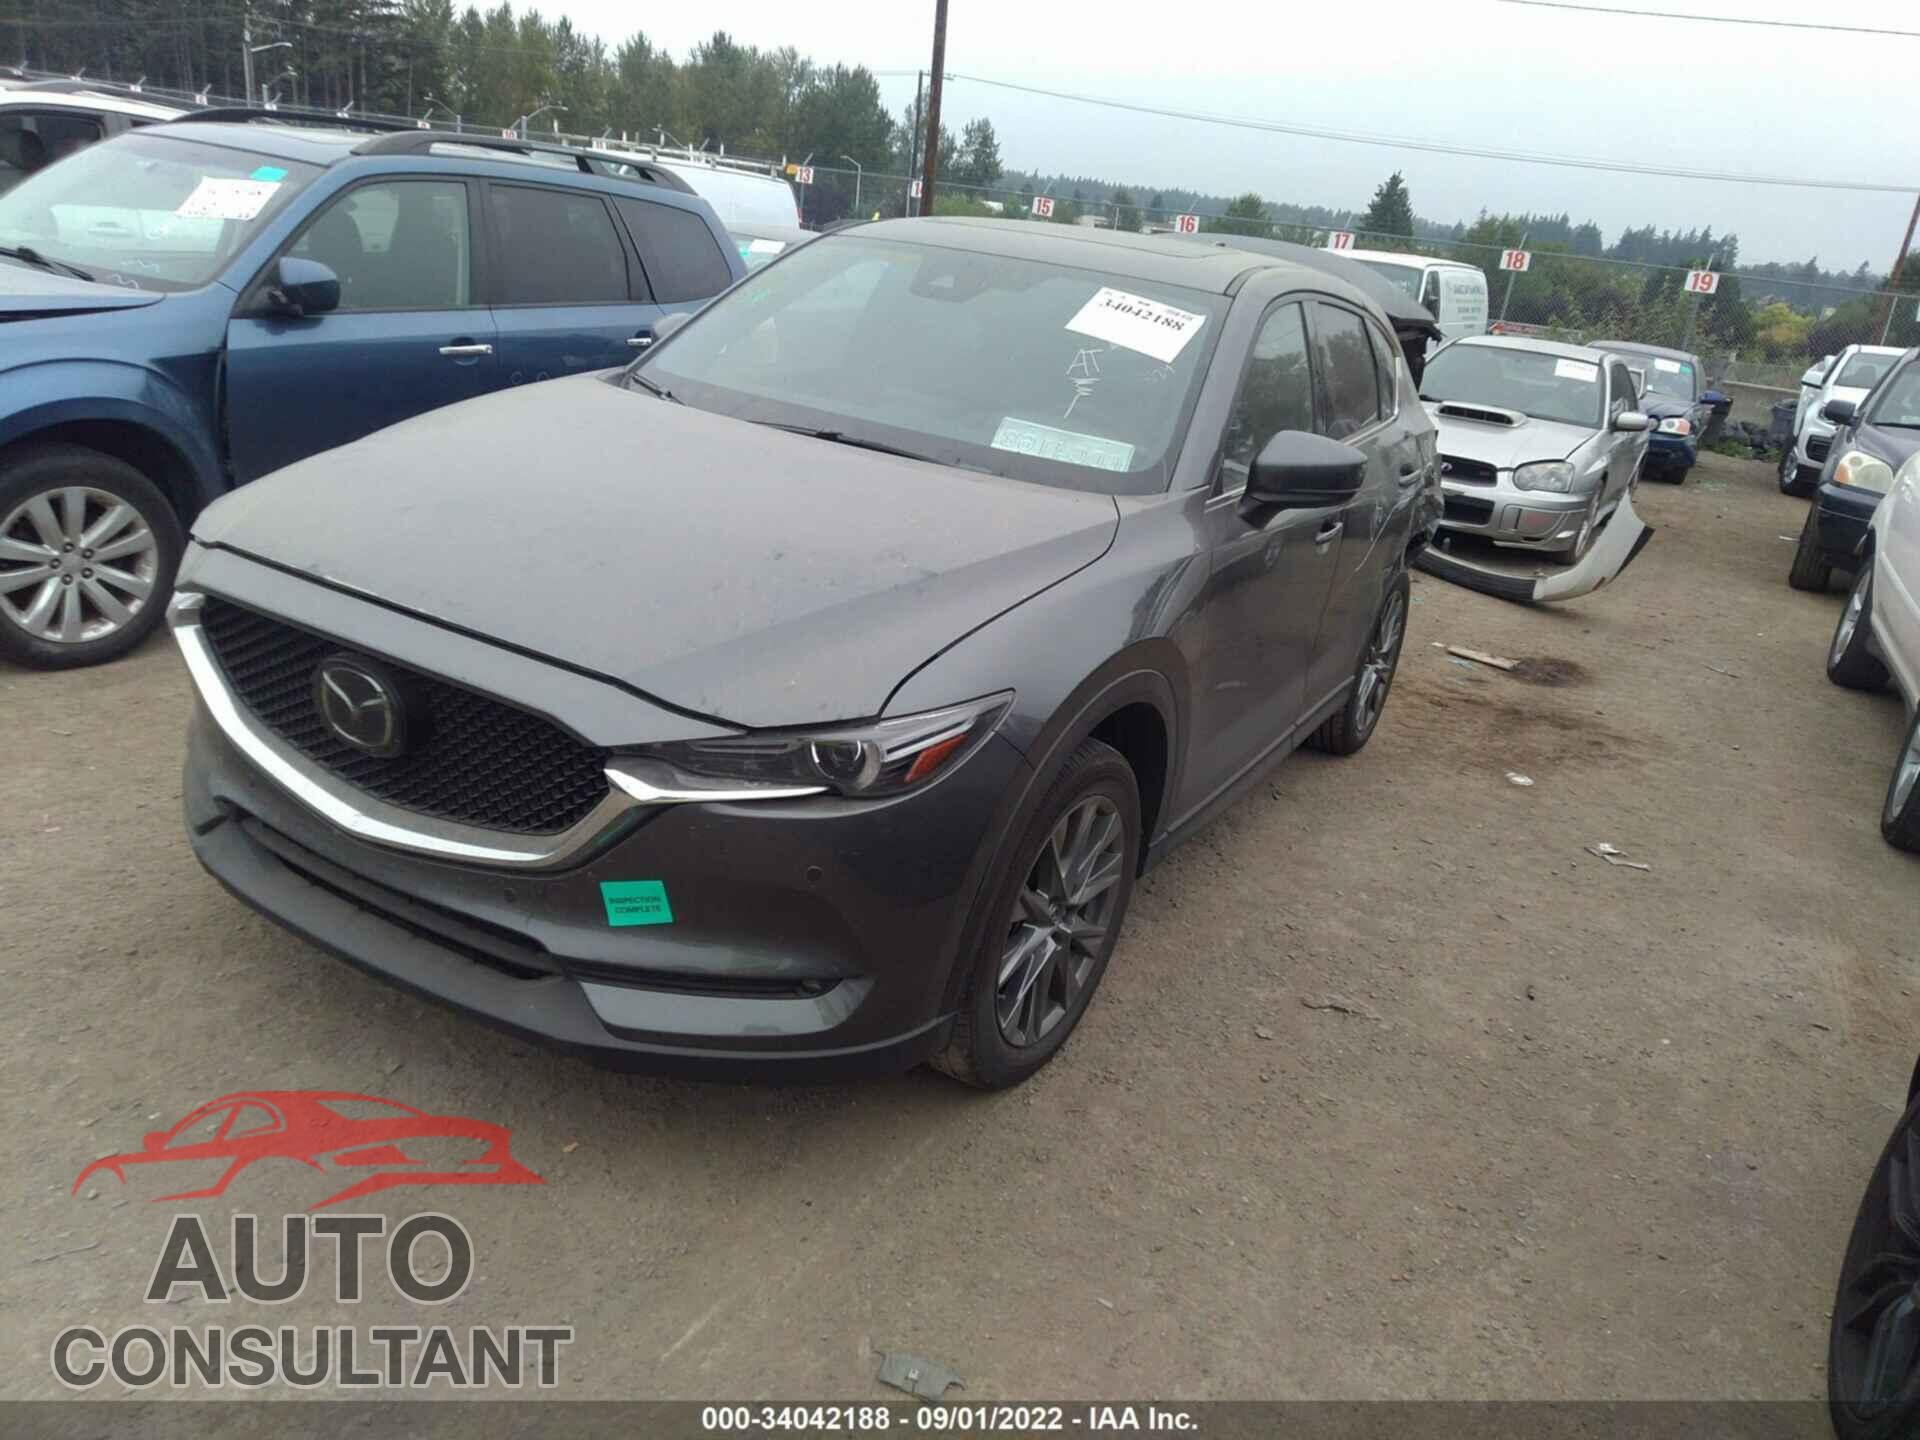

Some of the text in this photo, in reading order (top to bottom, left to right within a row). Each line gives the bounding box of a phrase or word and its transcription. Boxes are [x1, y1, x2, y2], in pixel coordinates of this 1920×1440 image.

[799, 166, 811, 183] 13
[1036, 198, 1050, 215] 15
[1179, 215, 1195, 233] 16
[1334, 231, 1350, 249] 17
[1505, 251, 1526, 270] 18
[1691, 271, 1713, 292] 19
[1099, 298, 1185, 331] 34042188
[615, 905, 661, 913] COMPLETE
